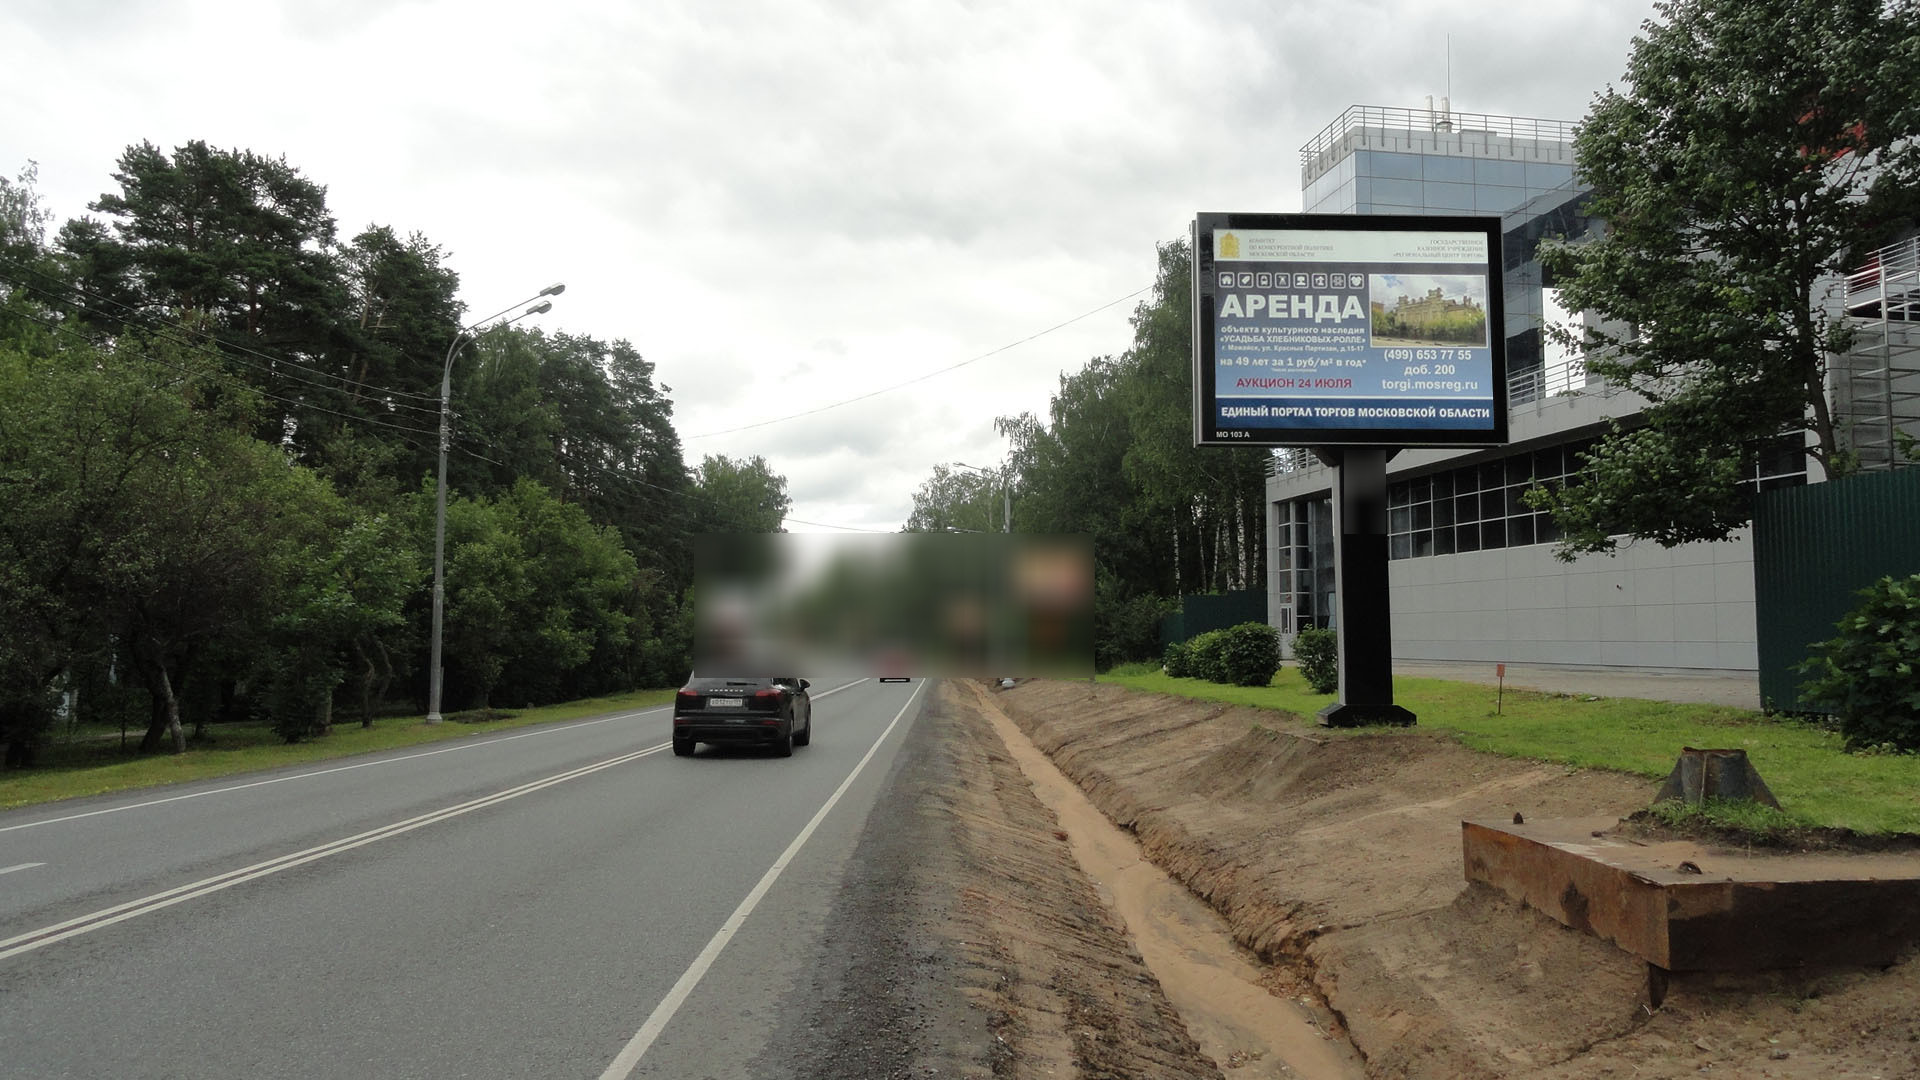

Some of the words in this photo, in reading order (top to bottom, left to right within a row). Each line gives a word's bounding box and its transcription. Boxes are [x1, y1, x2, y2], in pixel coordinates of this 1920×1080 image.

[1220, 294, 1365, 323] АРЕНДА
[1221, 325, 1259, 334] объекта
[1262, 327, 1318, 335] культурного
[1321, 327, 1364, 335] наследия
[1220, 335, 1264, 343] «УСАДЬБА
[1266, 335, 1366, 344] ХЛЕБНИКОВЫХ-РОЛЛЕ»
[1220, 358, 1232, 366] на
[1236, 357, 1249, 366] 49
[1252, 358, 1269, 366] лет
[1272, 358, 1283, 366] за
[1287, 357, 1293, 366] 1
[1384, 349, 1413, 362] (499)
[1416, 349, 1437, 360] 653
[1440, 350, 1455, 360] 77
[1458, 350, 1472, 360] 55
[1404, 364, 1431, 376] доб.
[1435, 364, 1455, 375] 200
[1236, 378, 1295, 389] АУКЦИОН
[1298, 378, 1311, 388] 24
[1315, 378, 1352, 388] ИЮЛЯ
[1382, 379, 1478, 392] torgi.mosreg.ru
[1221, 405, 1268, 418] ЕДИНЫЙ
[1271, 407, 1312, 417] ПОРТАЛ
[1314, 407, 1355, 417] ТОРГОВ
[1358, 406, 1436, 418] МОСКОВСКОЙ
[1439, 408, 1490, 418] ОБЛАСТИ
